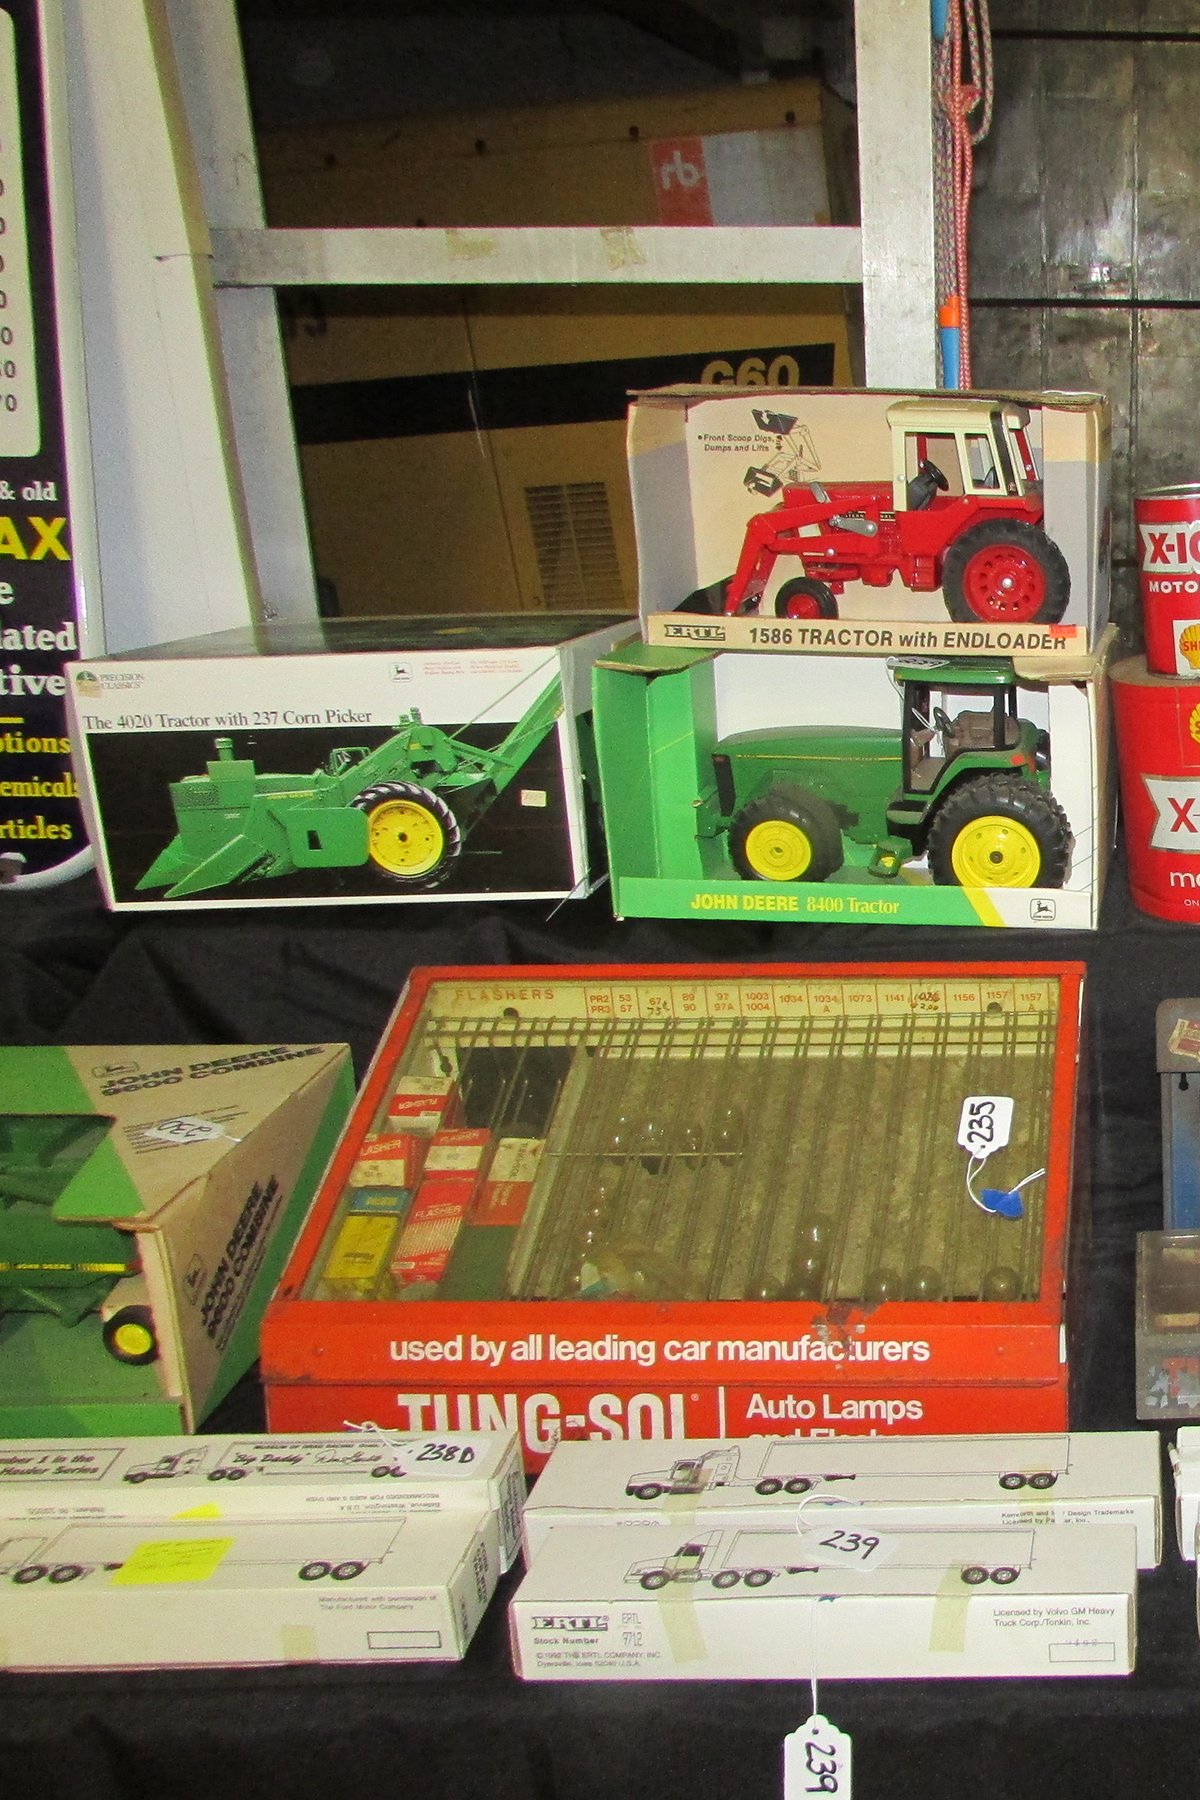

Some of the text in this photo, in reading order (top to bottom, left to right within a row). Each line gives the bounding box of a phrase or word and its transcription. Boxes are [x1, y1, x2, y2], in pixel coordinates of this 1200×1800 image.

[703, 434, 774, 444] Front Scoop Digs,
[704, 444, 769, 454] Dumps and Lifts
[22, 481, 57, 501] old
[664, 624, 726, 642] ERTL
[749, 628, 1067, 651] 1586 TRACTOR with ENDLOADER
[101, 673, 144, 683] PRECISION
[101, 681, 141, 690] CLASSICS
[83, 707, 373, 730] The 4020 Tractor with 237 Corn Picker
[690, 893, 900, 915] JOHN DEERE 8400 Tractor
[455, 988, 556, 1001] FLASHERS
[589, 995, 609, 1004] PR2
[745, 992, 769, 1001] 1003
[814, 994, 838, 1003] 1034
[848, 994, 873, 1003] 1073
[952, 993, 976, 1002] 1156
[986, 990, 1009, 1000] 1157
[1020, 992, 1043, 1001] 1157
[591, 1004, 611, 1014] PR3
[620, 1004, 633, 1013] 57
[683, 1002, 697, 1012] 90
[714, 1002, 734, 1012] 97A
[746, 1002, 770, 1012] 1004
[822, 1004, 831, 1014] A
[101, 1046, 289, 1089] JOHN DEERE
[190, 1047, 326, 1080] COMBINE
[398, 1098, 439, 1110] FLASHER
[966, 1100, 996, 1144] 235
[414, 1205, 463, 1219] FLASHER
[201, 1256, 230, 1326] JOHN
[390, 1333, 931, 1367] used by all leading car manufacturers
[746, 1393, 924, 1425] Auto Lamps
[1094, 1508, 1135, 1516] Trademarks
[819, 1529, 880, 1560] 239
[993, 1607, 1116, 1618] Licensed by Volvo GM Heavy
[531, 1615, 609, 1632] ERTL
[994, 1618, 1017, 1627] Truck
[533, 1637, 599, 1645] Stock Number
[804, 1739, 840, 1794] 239
